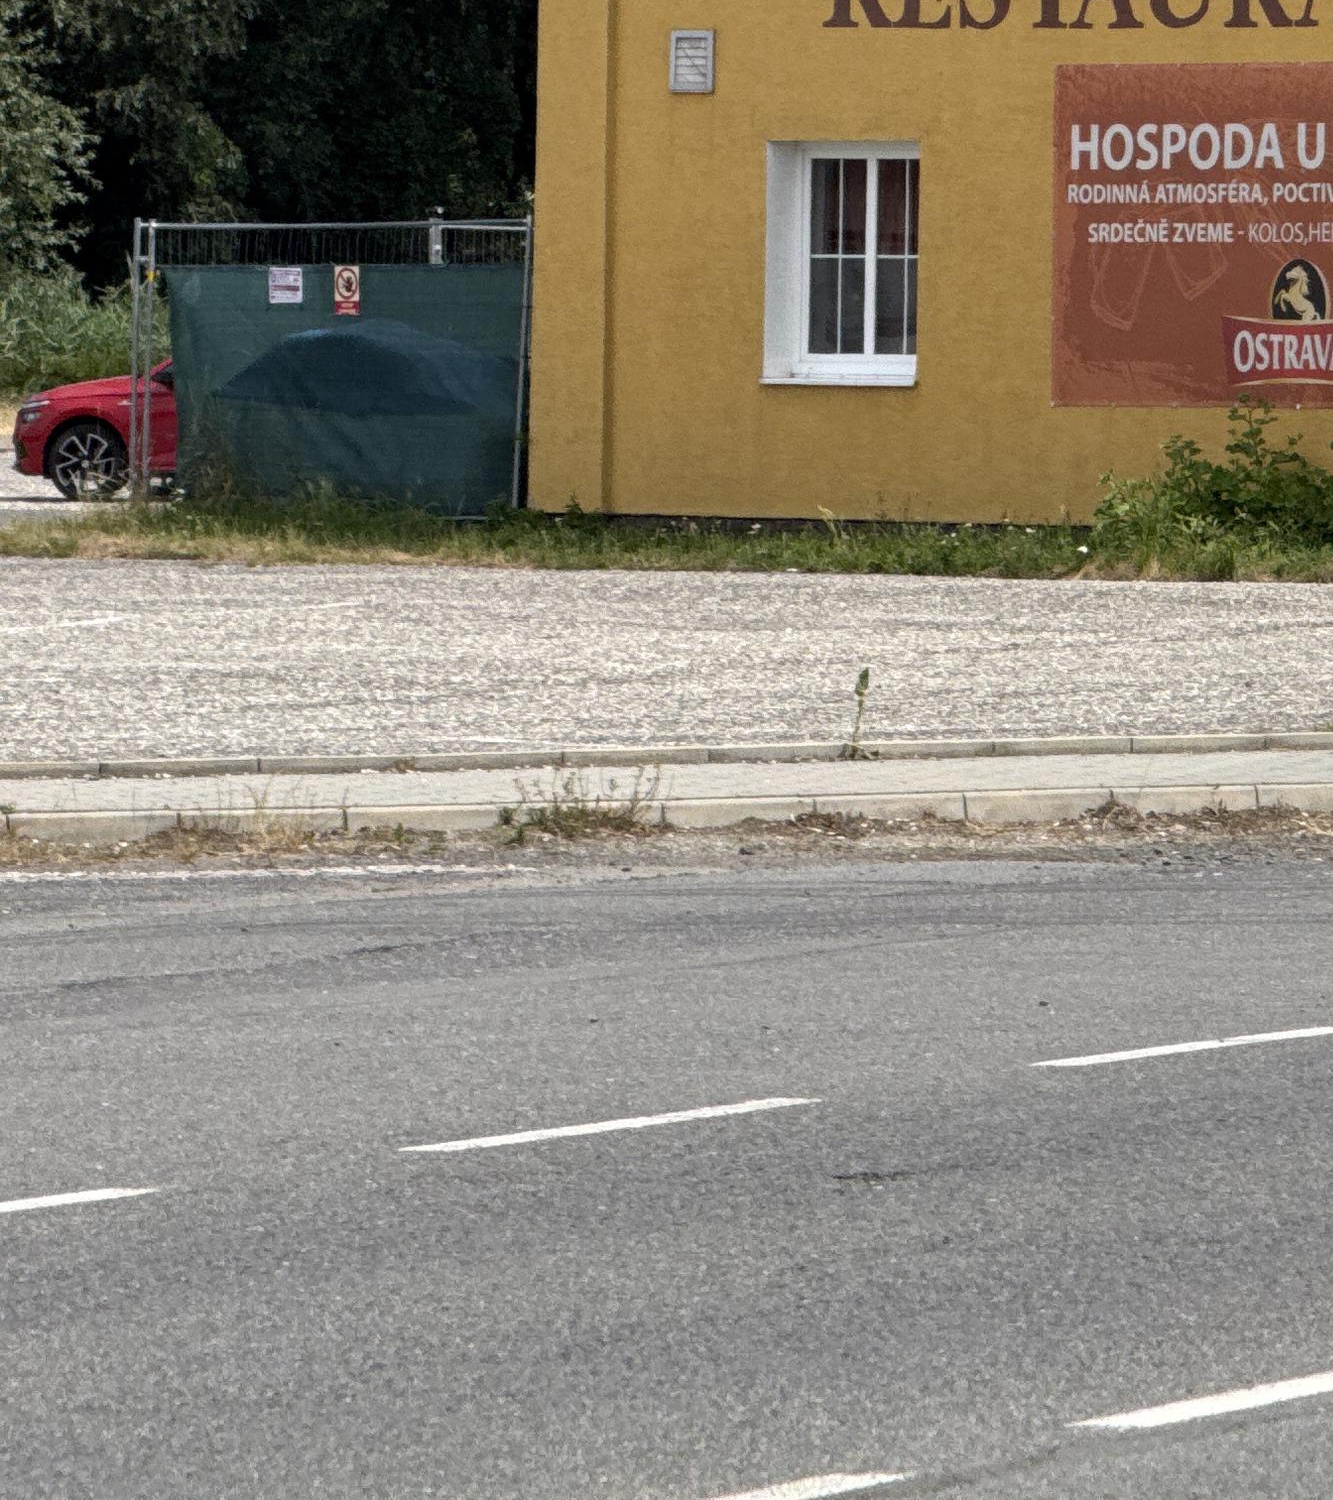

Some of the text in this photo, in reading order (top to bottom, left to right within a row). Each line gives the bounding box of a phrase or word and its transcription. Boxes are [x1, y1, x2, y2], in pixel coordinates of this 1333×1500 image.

[1070, 123, 1284, 171] HOSPODA
[1297, 122, 1326, 170] U
[1067, 180, 1150, 204] RODINNÁ
[1155, 179, 1269, 205] ATMOSFÉRA,
[1088, 218, 1169, 243] SRDEČNĚ
[1172, 222, 1234, 243] ZVEME
